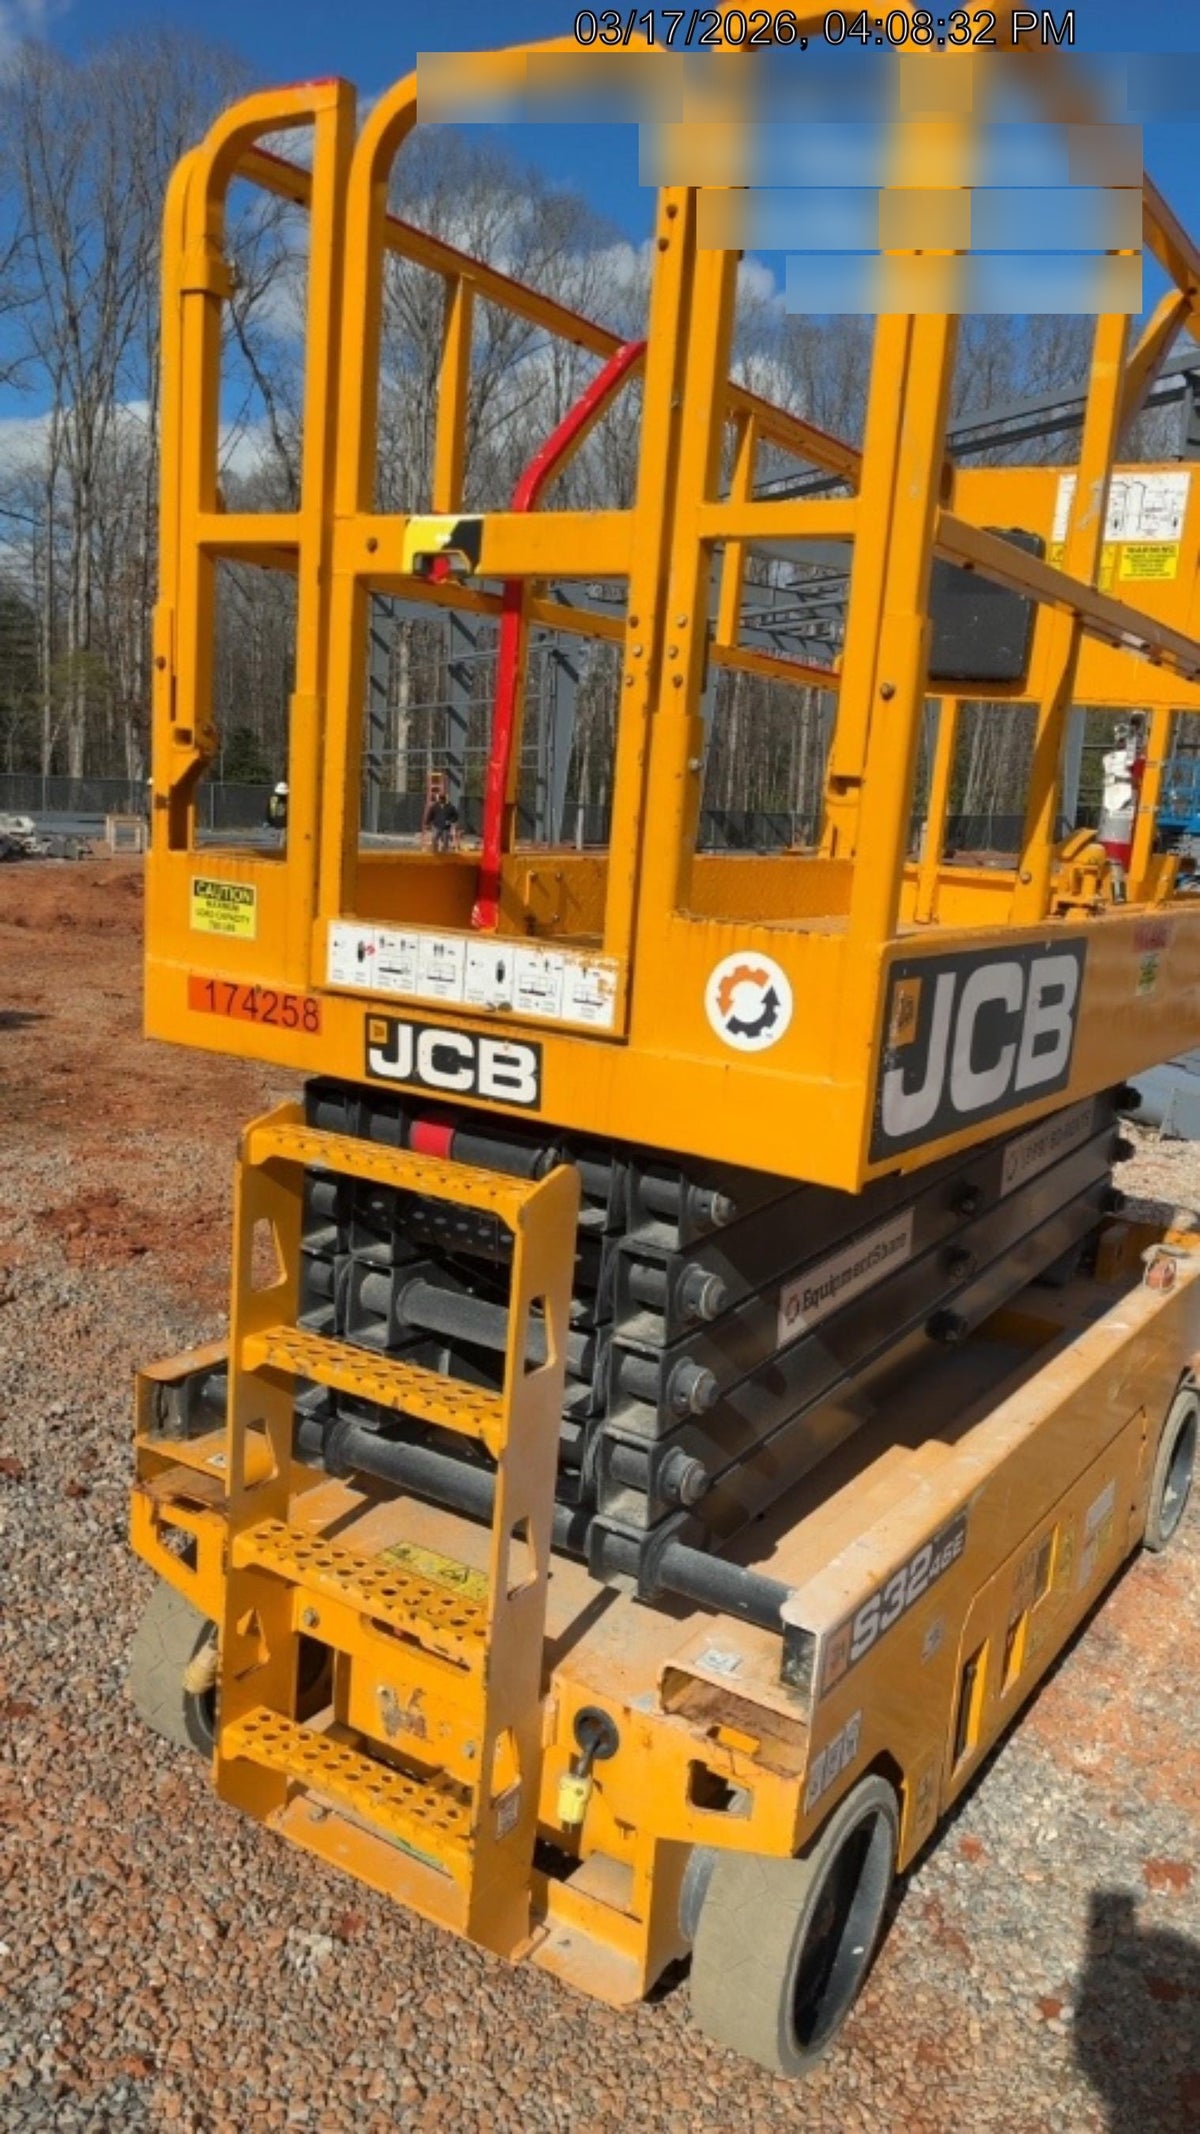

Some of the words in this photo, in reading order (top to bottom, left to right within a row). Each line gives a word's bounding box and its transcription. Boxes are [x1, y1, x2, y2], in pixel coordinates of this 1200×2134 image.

[196, 881, 251, 903] CAUTION
[205, 980, 319, 1033] 174258
[881, 954, 1079, 1137] JCB
[368, 1023, 537, 1104] JCB
[802, 1231, 907, 1312] EquipmentShare
